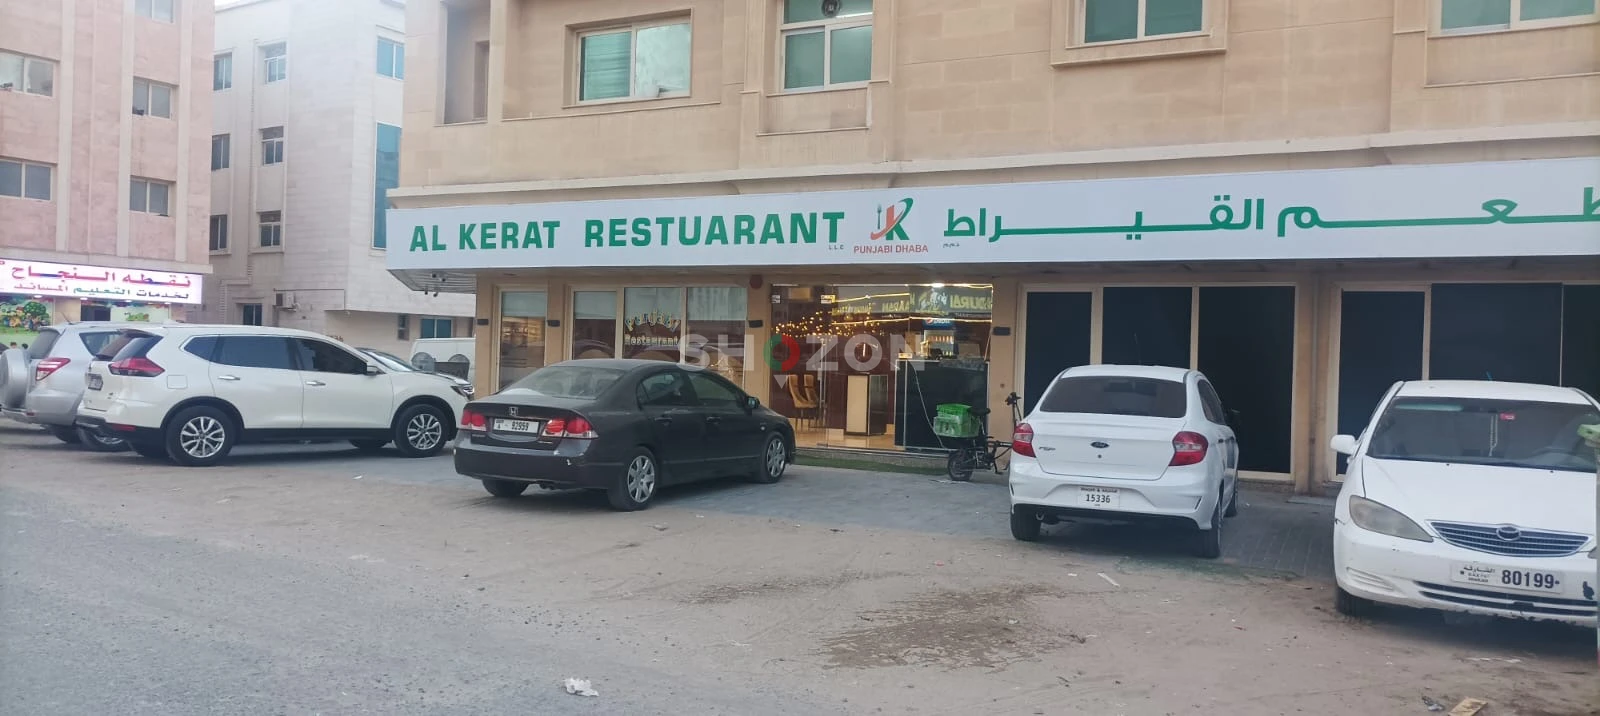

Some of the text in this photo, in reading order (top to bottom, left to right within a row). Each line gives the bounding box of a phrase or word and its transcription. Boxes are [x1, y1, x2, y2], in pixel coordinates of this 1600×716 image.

[943, 186, 1600, 243] طعم القيراط
[409, 211, 845, 253] AL KERAT RESTUARANT
[853, 244, 929, 255] PUNJABI DHABA
[11, 264, 116, 284] النجاح
[1085, 494, 1111, 503] 15336
[1501, 569, 1555, 589] 80199
